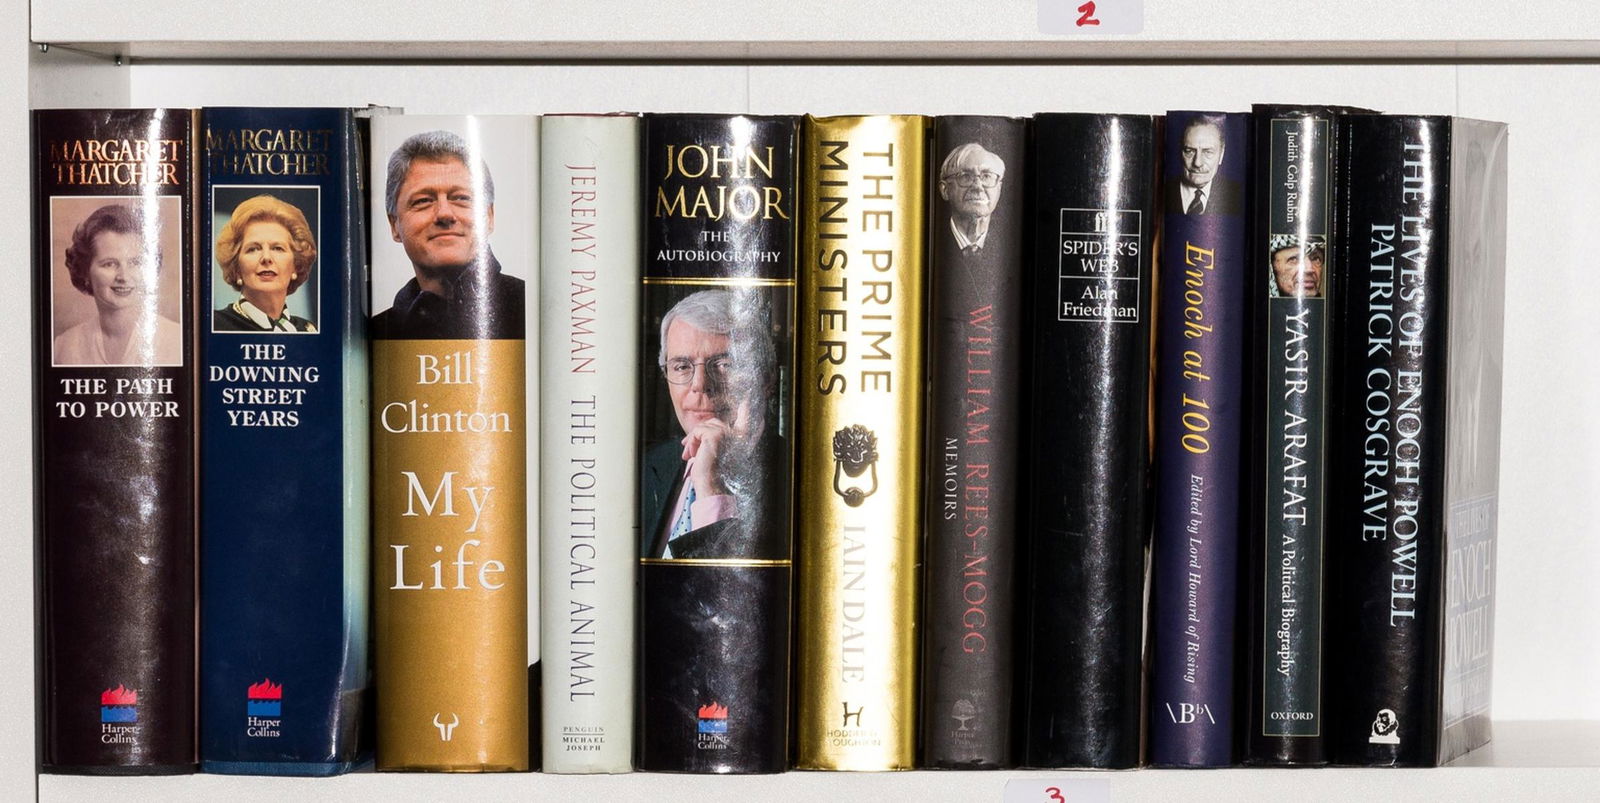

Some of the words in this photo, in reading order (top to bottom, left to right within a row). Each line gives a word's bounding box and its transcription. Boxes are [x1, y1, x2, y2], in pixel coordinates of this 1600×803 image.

[1075, 1, 1101, 27] 2
[50, 139, 183, 162] MARGARET
[205, 128, 333, 152] MARGARET
[1285, 130, 1299, 162] Judith
[52, 161, 180, 185] THATCHER
[209, 151, 331, 176] THATCHER
[664, 145, 774, 180] JOHN
[1284, 164, 1298, 189] Colp
[655, 185, 790, 222] MAJOR
[862, 143, 894, 232] THE
[564, 163, 597, 259] JEREMY
[1286, 192, 1298, 223] Rubin
[701, 230, 730, 242] THE
[656, 249, 782, 263] AUTOBIOGRAPHY
[817, 140, 849, 396] MINISTERS
[1081, 286, 1118, 300] Alan
[1184, 241, 1215, 339] Enoch
[1367, 223, 1396, 358] PATRICK
[570, 270, 597, 374] PAXMAN
[861, 250, 893, 393] PRIME
[1398, 311, 1424, 356] OF
[240, 344, 286, 361] THE
[416, 351, 473, 385] Bill
[1183, 350, 1211, 382] at
[1285, 308, 1310, 400] YASIR
[60, 378, 107, 395] THE
[116, 377, 174, 395] PATH
[209, 366, 320, 383] DOWNING
[966, 303, 993, 446] WILLIAM
[56, 401, 86, 418] TO
[95, 401, 180, 418] POWER
[222, 388, 306, 405] STREET
[227, 410, 299, 427] YEARS
[381, 400, 512, 433] Clinton
[570, 395, 596, 446] THE
[1181, 393, 1210, 454] 100
[1396, 369, 1422, 485] ENOCH
[1283, 409, 1308, 526] ARAFAT
[1362, 367, 1392, 541] COSGRAVE
[944, 437, 958, 521] MEMOIRS
[1190, 474, 1203, 515] Edited
[401, 471, 495, 533] My
[570, 458, 596, 590] POLITICAL
[1187, 517, 1202, 534] by
[1282, 534, 1296, 546] A
[390, 539, 505, 590] Life
[843, 526, 866, 591] IAIN
[962, 463, 990, 655] REES-MOGG
[1189, 537, 1201, 568] Lord
[1390, 498, 1419, 627] POWELL
[1282, 550, 1296, 603] Political
[1450, 539, 1492, 609] ENOCH
[1188, 572, 1201, 621] Howard
[841, 600, 865, 683] DALE
[1185, 624, 1200, 640] of
[1277, 608, 1295, 677] Biography
[569, 600, 596, 702] ANIMAL
[1184, 641, 1199, 684] Rising
[101, 723, 140, 736] Harper
[247, 717, 281, 728] Harper
[247, 727, 280, 738] Collins
[1270, 711, 1314, 721] OXFORD
[101, 734, 137, 745] Collins
[562, 736, 605, 744] MICHAEL
[697, 741, 727, 750] Collins
